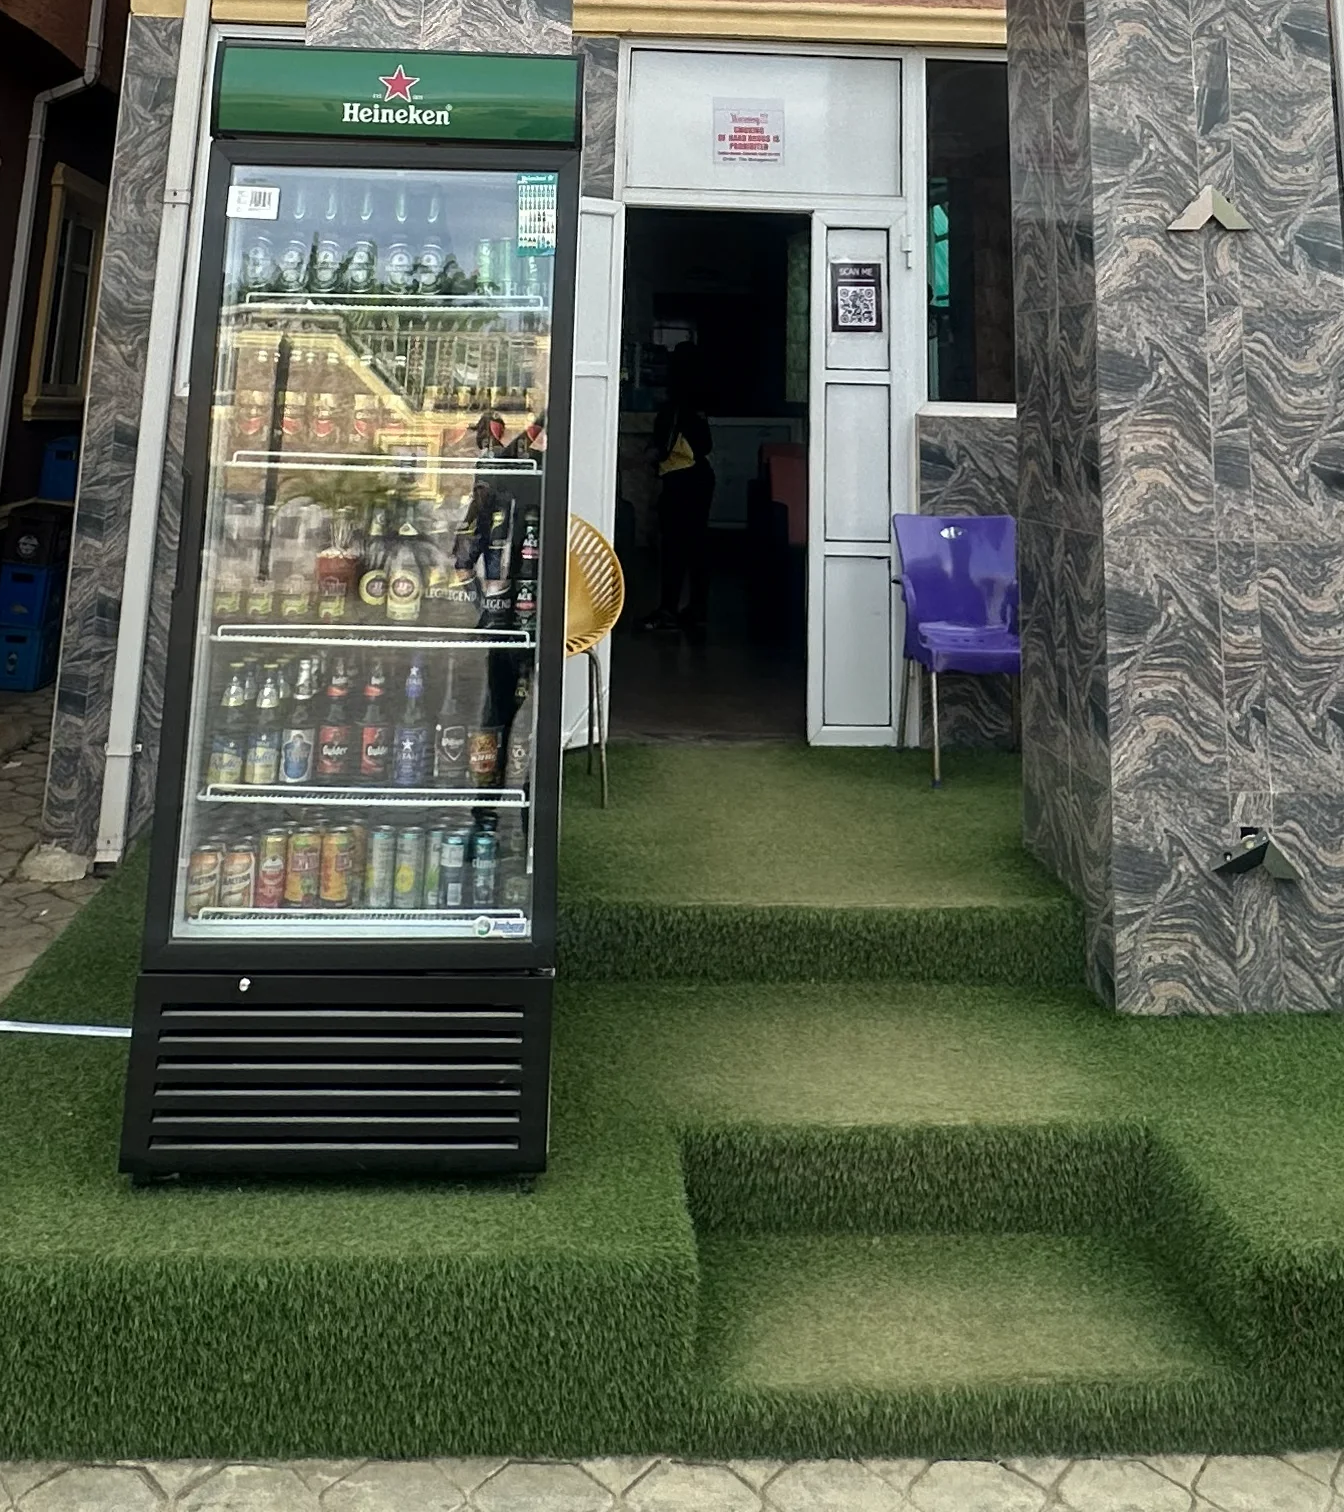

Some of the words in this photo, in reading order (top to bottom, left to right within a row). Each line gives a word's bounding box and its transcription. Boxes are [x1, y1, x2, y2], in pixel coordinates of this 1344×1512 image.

[342, 102, 451, 126] Heineken
[838, 267, 859, 276] SCAN
[860, 267, 873, 276] ME
